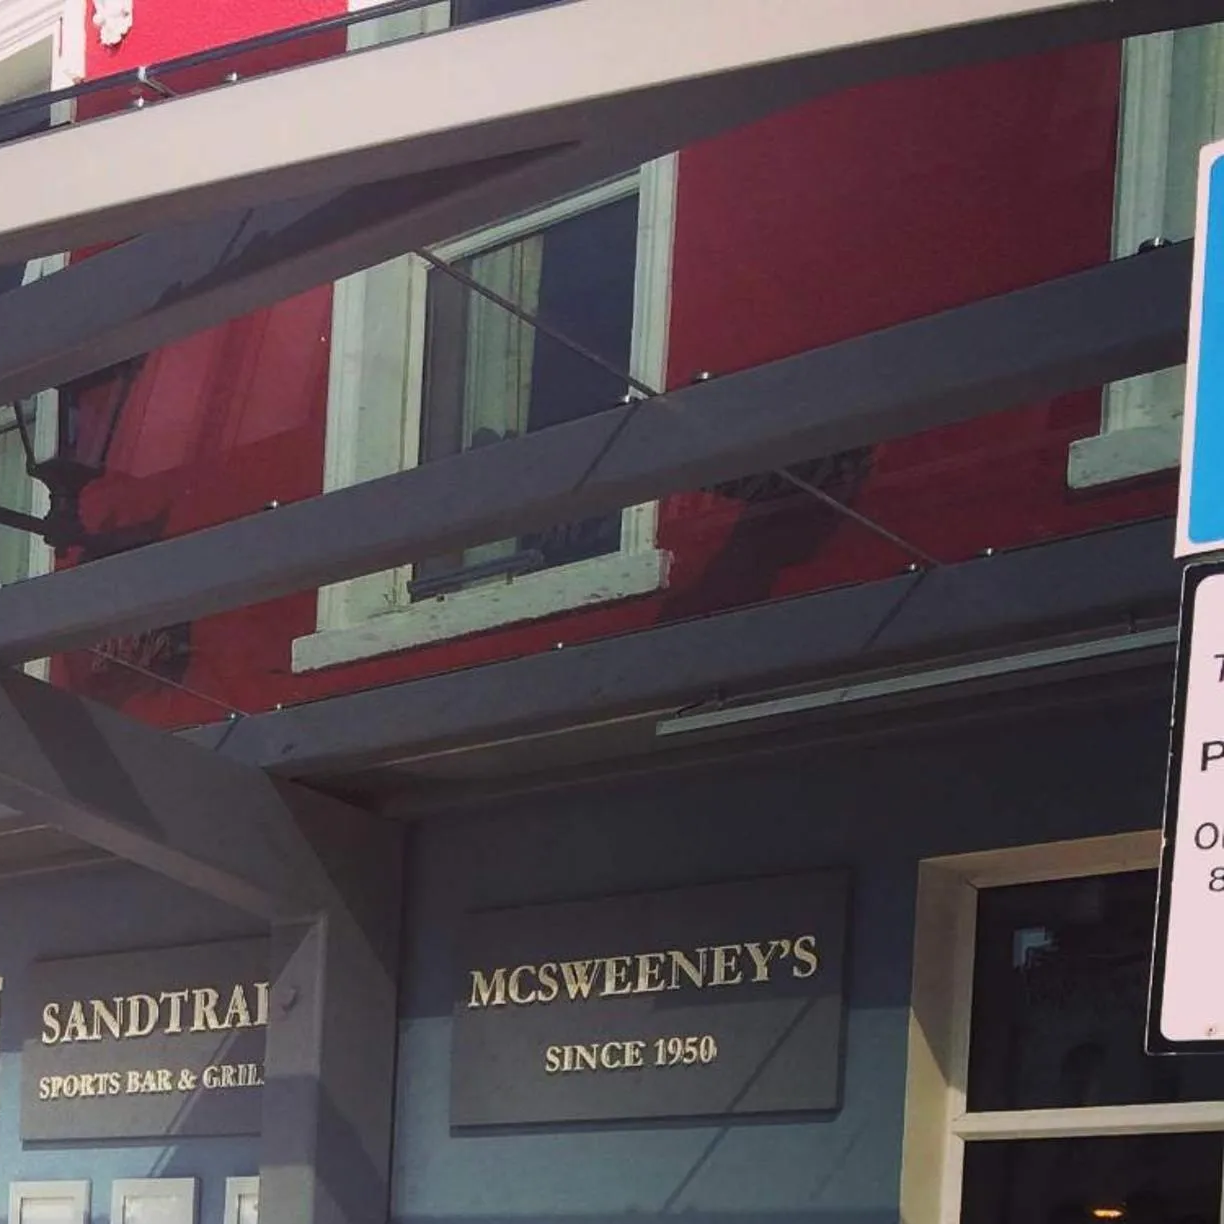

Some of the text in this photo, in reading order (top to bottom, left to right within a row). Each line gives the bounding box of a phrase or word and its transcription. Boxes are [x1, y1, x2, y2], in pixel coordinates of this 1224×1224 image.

[468, 936, 818, 1008] MCSWEENEY'S
[544, 1035, 717, 1072] SINCE 1950
[39, 1072, 121, 1099] SPORTS
[127, 1069, 172, 1093] BAR
[177, 1069, 196, 1090] &
